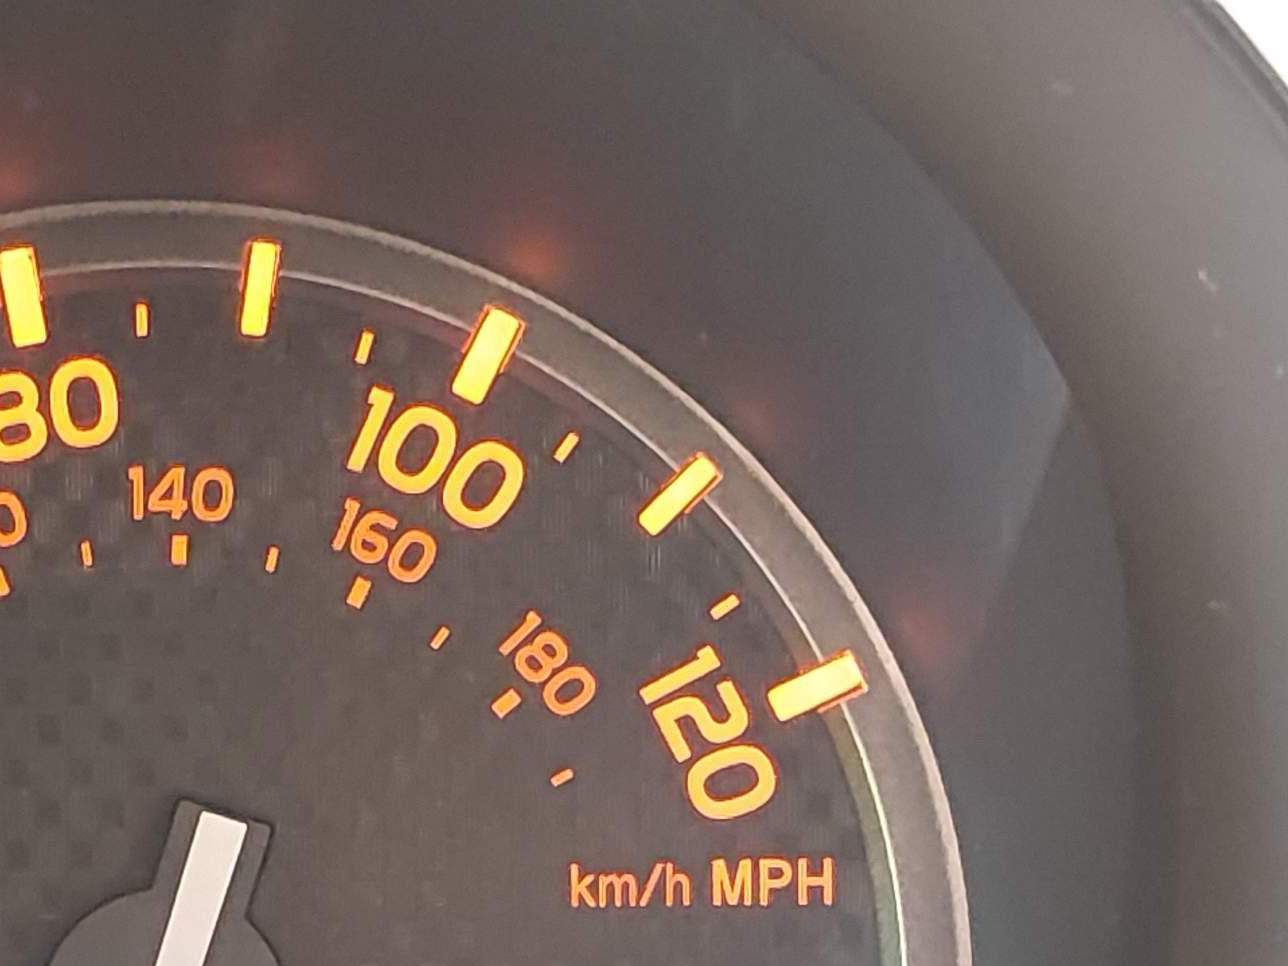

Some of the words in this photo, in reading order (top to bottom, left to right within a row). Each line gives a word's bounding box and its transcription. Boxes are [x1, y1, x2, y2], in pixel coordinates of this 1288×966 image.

[127, 465, 234, 522] 140
[345, 385, 525, 529] 100
[331, 498, 438, 583] 160
[497, 609, 597, 716] 180
[638, 644, 778, 820] 120
[568, 862, 693, 907] km/h
[710, 856, 835, 906] MPH
